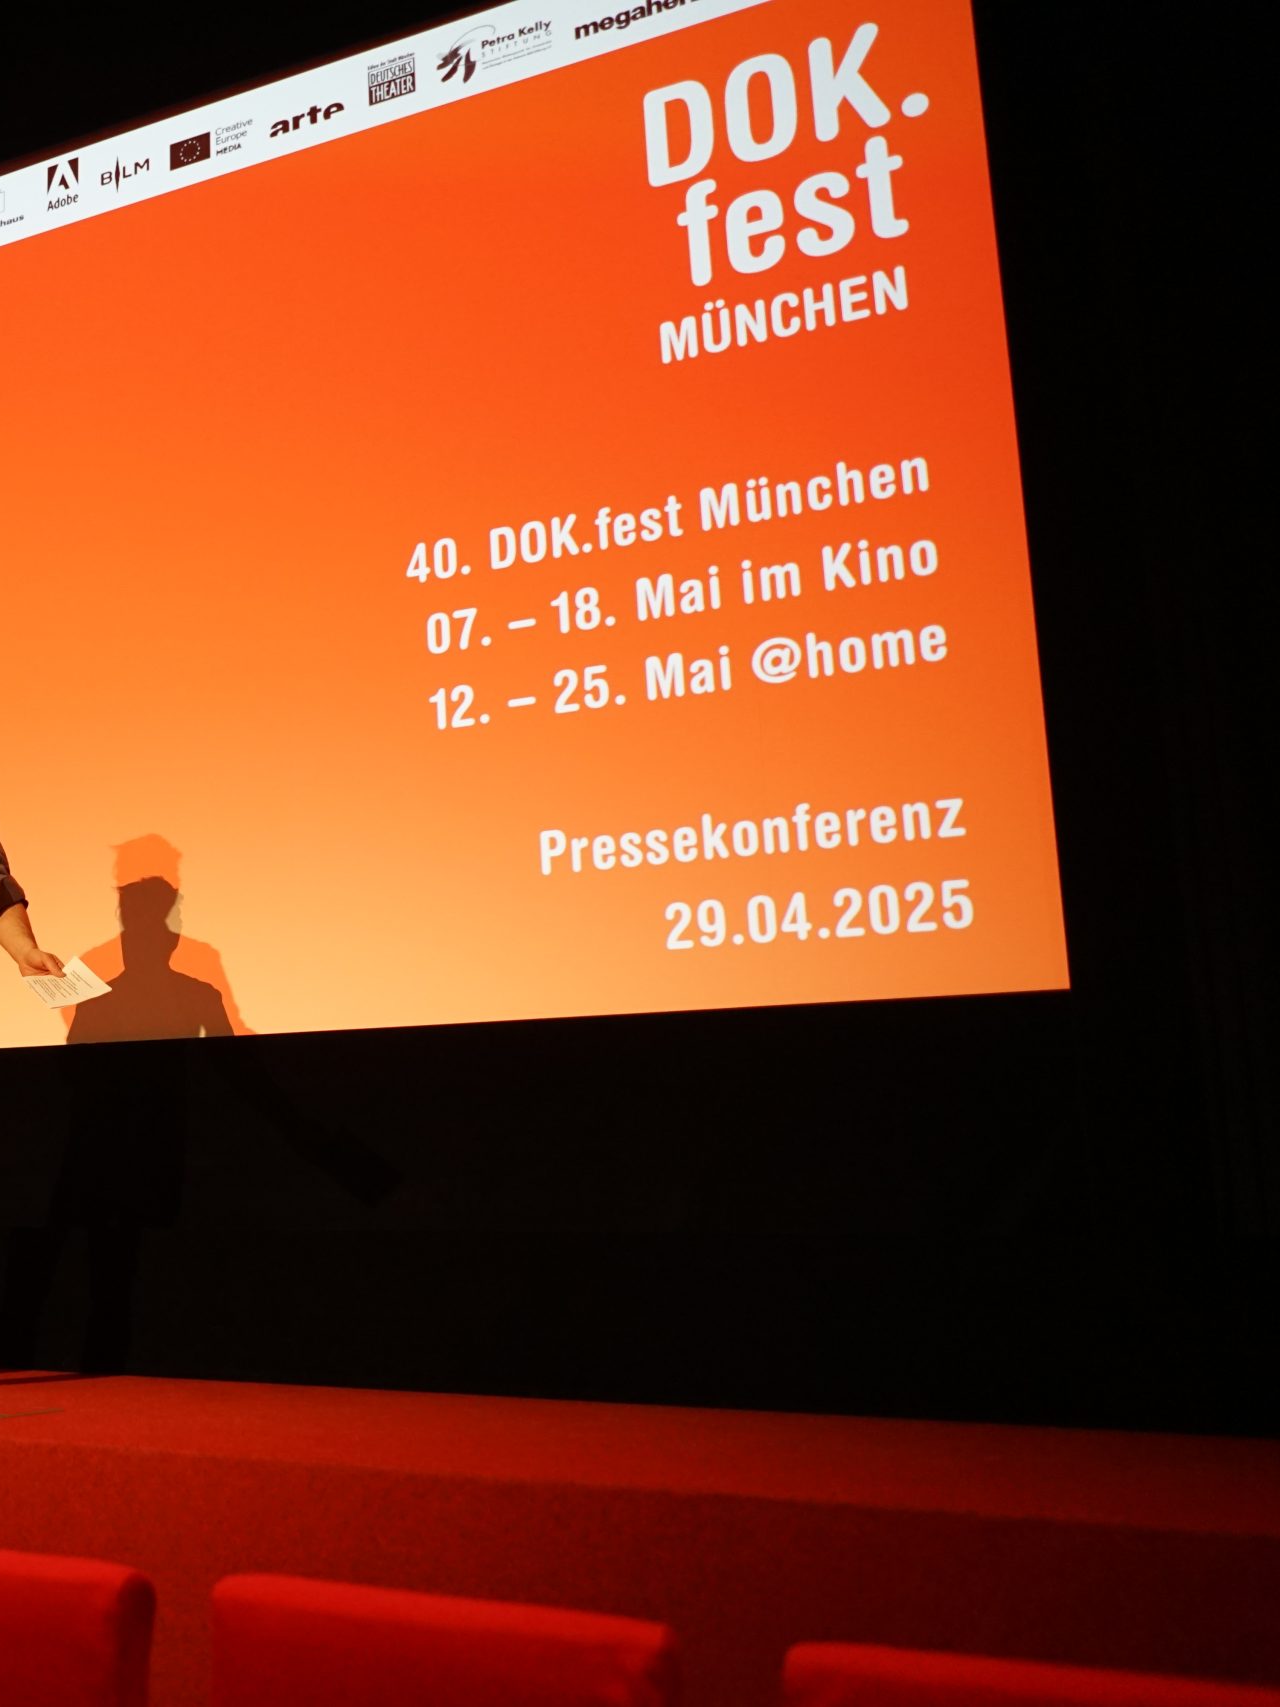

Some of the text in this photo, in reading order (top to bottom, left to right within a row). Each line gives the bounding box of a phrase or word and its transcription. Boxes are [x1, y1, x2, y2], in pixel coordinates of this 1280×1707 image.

[481, 20, 552, 49] Petra Kelly
[575, 0, 700, 40] megahe
[370, 60, 413, 85] DEUTSCHES
[370, 75, 414, 104] THEATER
[269, 102, 345, 138] arte
[642, 22, 930, 188] DOK.
[215, 118, 253, 136] Creative
[215, 130, 248, 146] Europe
[216, 142, 242, 157] MEDIA
[47, 194, 79, 212] Adobe
[676, 135, 910, 287] fest
[659, 265, 909, 365] MÜNCHEN
[405, 456, 930, 583] 40. DOK.fest München
[426, 607, 492, 655] 07.
[550, 586, 616, 634] 18.
[635, 565, 721, 622] Mai
[741, 559, 801, 605] im
[821, 538, 939, 592] Kino
[428, 684, 491, 731] 12.
[552, 664, 626, 714] 25.
[644, 645, 732, 701] Mai
[751, 624, 948, 684] @home
[539, 797, 967, 876] Pressekonferenz
[663, 878, 975, 951] 29.04.2025
